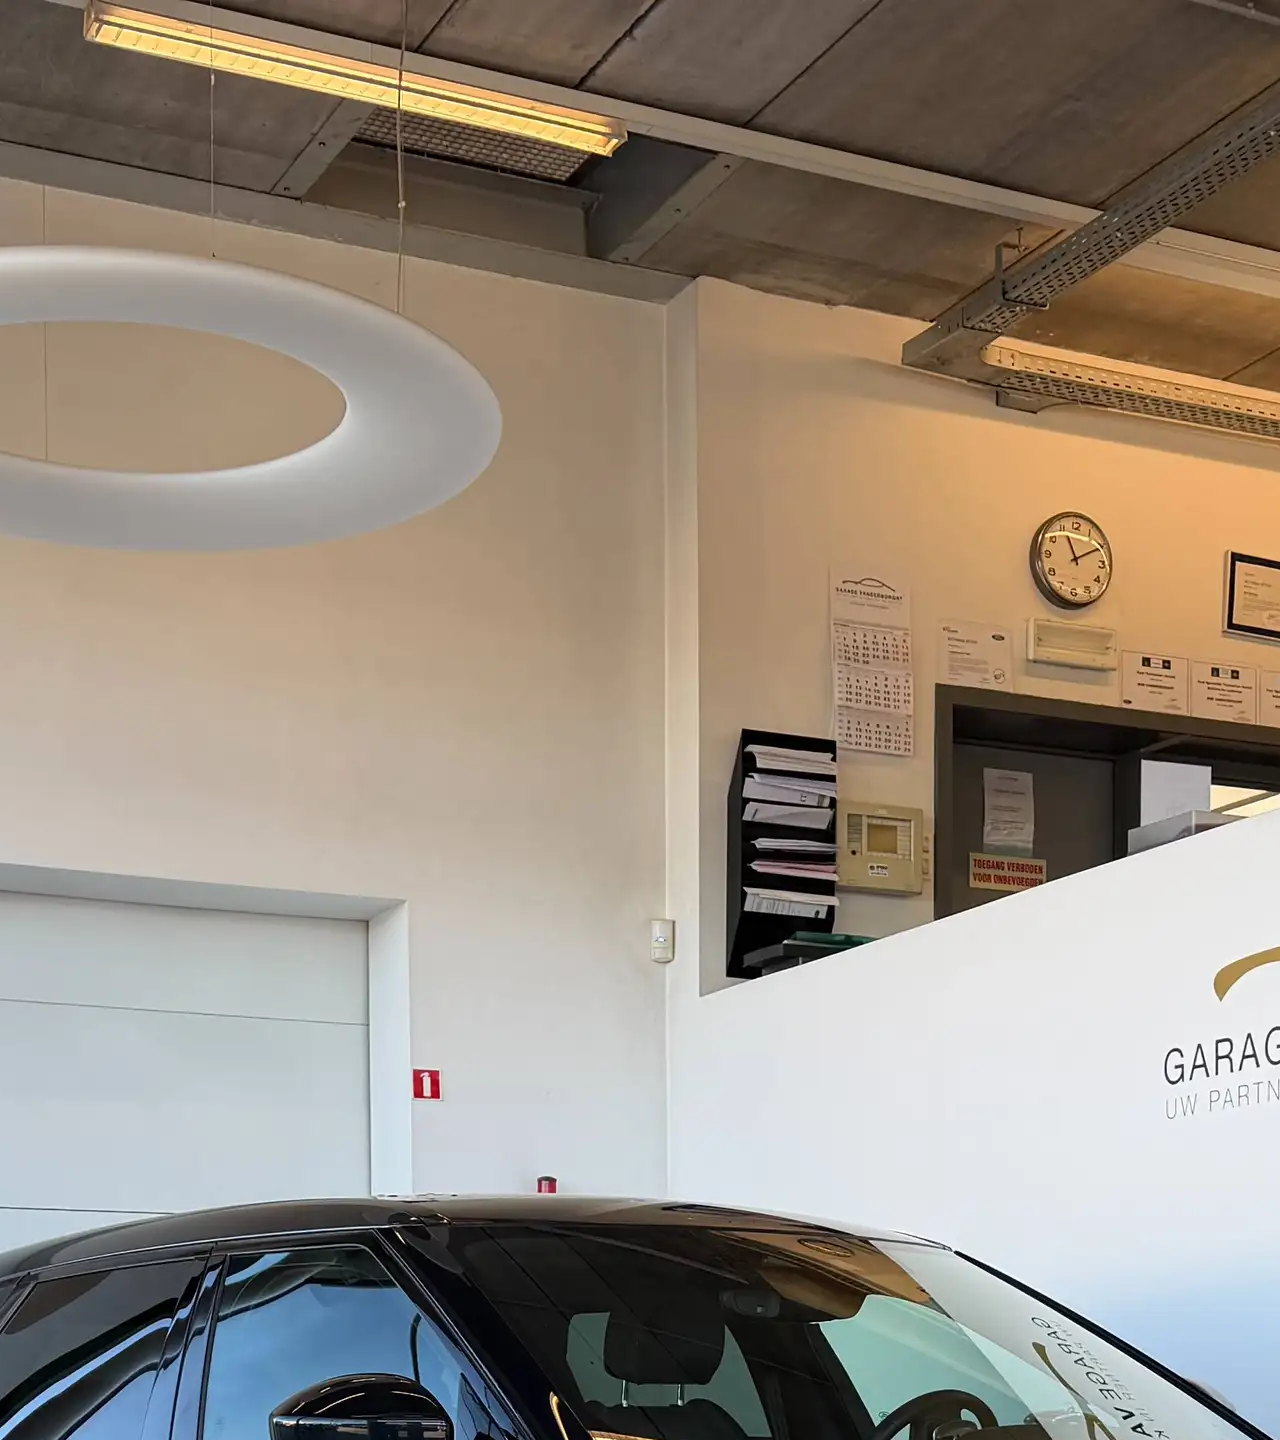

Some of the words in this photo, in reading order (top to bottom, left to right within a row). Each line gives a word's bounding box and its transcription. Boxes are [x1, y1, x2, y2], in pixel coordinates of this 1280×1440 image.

[1071, 521, 1082, 532] 12
[1044, 549, 1053, 558] 9
[1098, 560, 1106, 569] 3
[1047, 567, 1057, 576] 8
[1093, 575, 1101, 584] 4
[1070, 588, 1078, 597] 6
[1083, 586, 1091, 595] 5
[973, 858, 1005, 871] TOEGANG
[1006, 863, 1043, 874] VERBODEN
[972, 872, 992, 883] VOOR
[1165, 1093, 1198, 1120] UW
